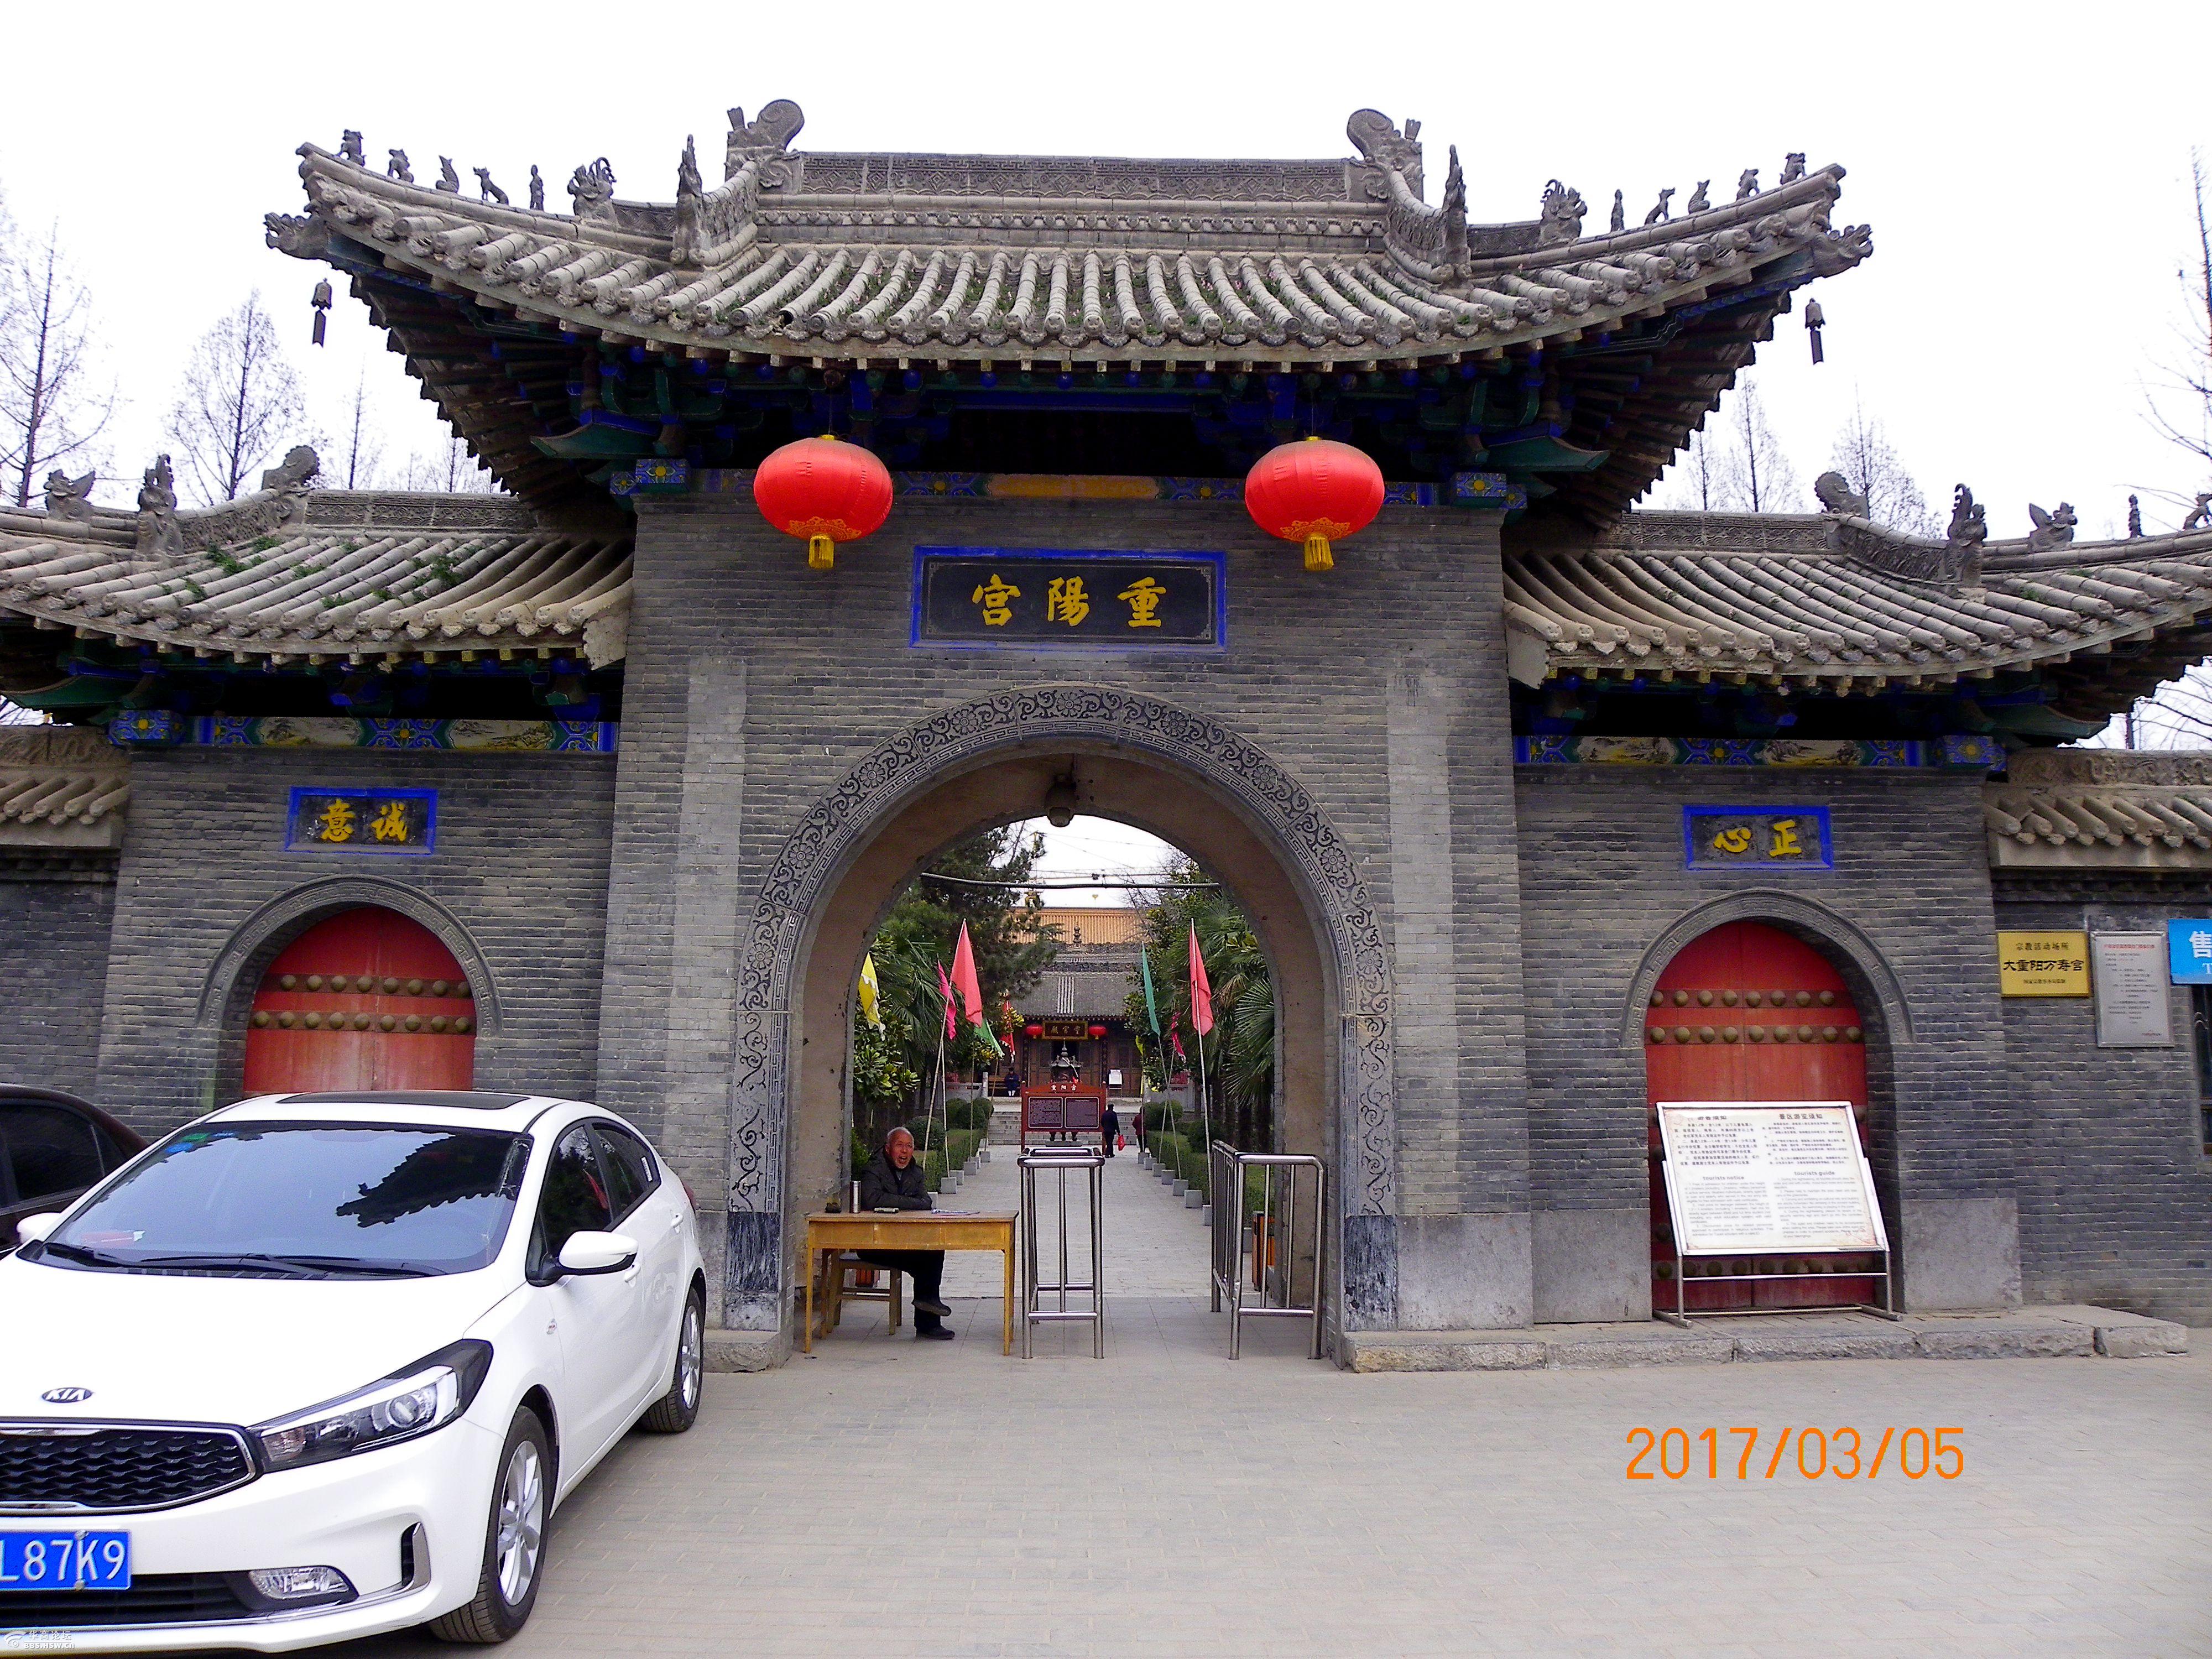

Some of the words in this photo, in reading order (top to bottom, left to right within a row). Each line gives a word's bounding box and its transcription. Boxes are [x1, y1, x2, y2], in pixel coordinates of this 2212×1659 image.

[2003, 959, 2084, 972] 大重阳万寿宫
[45, 1388, 86, 1400] KIA
